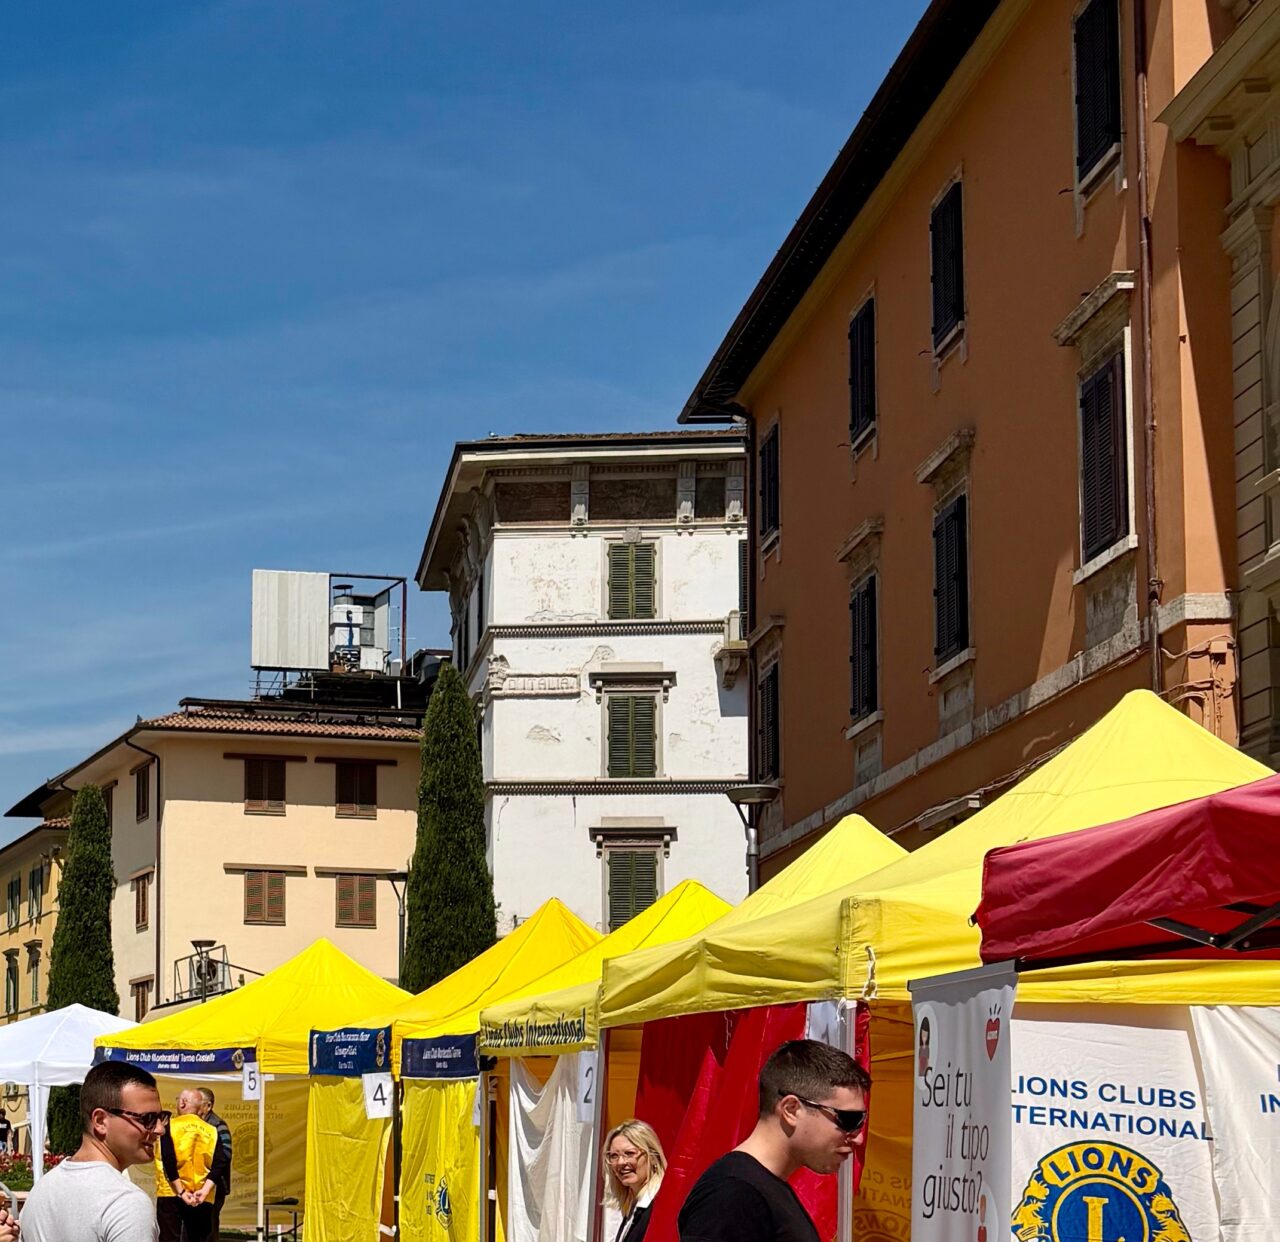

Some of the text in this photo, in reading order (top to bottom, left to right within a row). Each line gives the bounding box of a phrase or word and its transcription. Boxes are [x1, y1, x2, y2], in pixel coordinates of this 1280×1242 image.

[503, 1019, 524, 1048] Clubs
[525, 1007, 586, 1048] International
[126, 1051, 139, 1062] Lions
[140, 1052, 151, 1062] Club
[248, 1070, 257, 1091] 5
[372, 1082, 388, 1107] 4
[583, 1066, 594, 1104] 2
[922, 1061, 973, 1108] Sei tu
[1098, 1083, 1196, 1110] CLUBS
[946, 1113, 989, 1170] il tipo
[1011, 1104, 1213, 1141] TERNATIONAL
[1048, 1146, 1153, 1190] LIONS
[922, 1164, 983, 1219] giusto?
